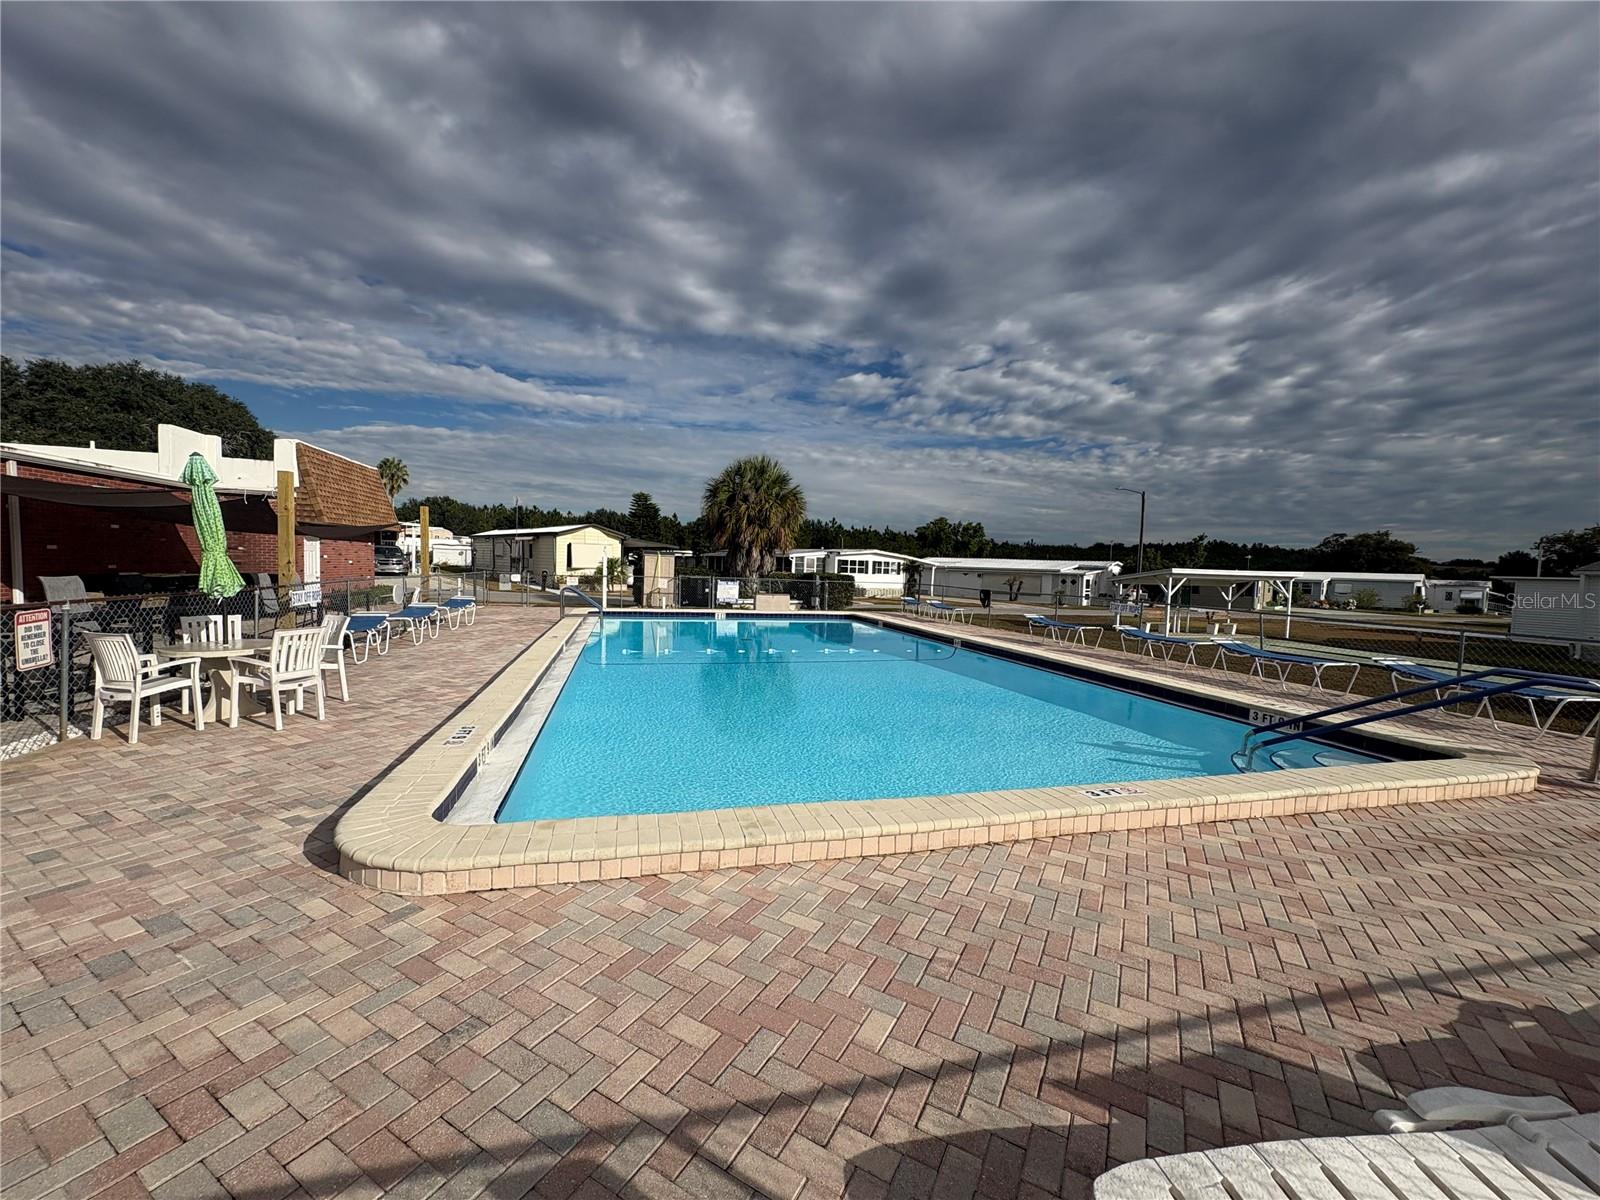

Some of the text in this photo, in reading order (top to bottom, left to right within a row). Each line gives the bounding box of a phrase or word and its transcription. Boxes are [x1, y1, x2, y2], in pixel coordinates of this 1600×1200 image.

[292, 592, 303, 605] STAY
[18, 612, 48, 624] ATTENTION
[24, 625, 32, 633] DID
[21, 631, 46, 641] REMEMBER
[30, 639, 45, 648] CLOSE
[21, 654, 48, 665] UMBRELLA?
[1252, 711, 1259, 721] 3
[1262, 714, 1274, 725] FT
[1099, 788, 1122, 796] FT
